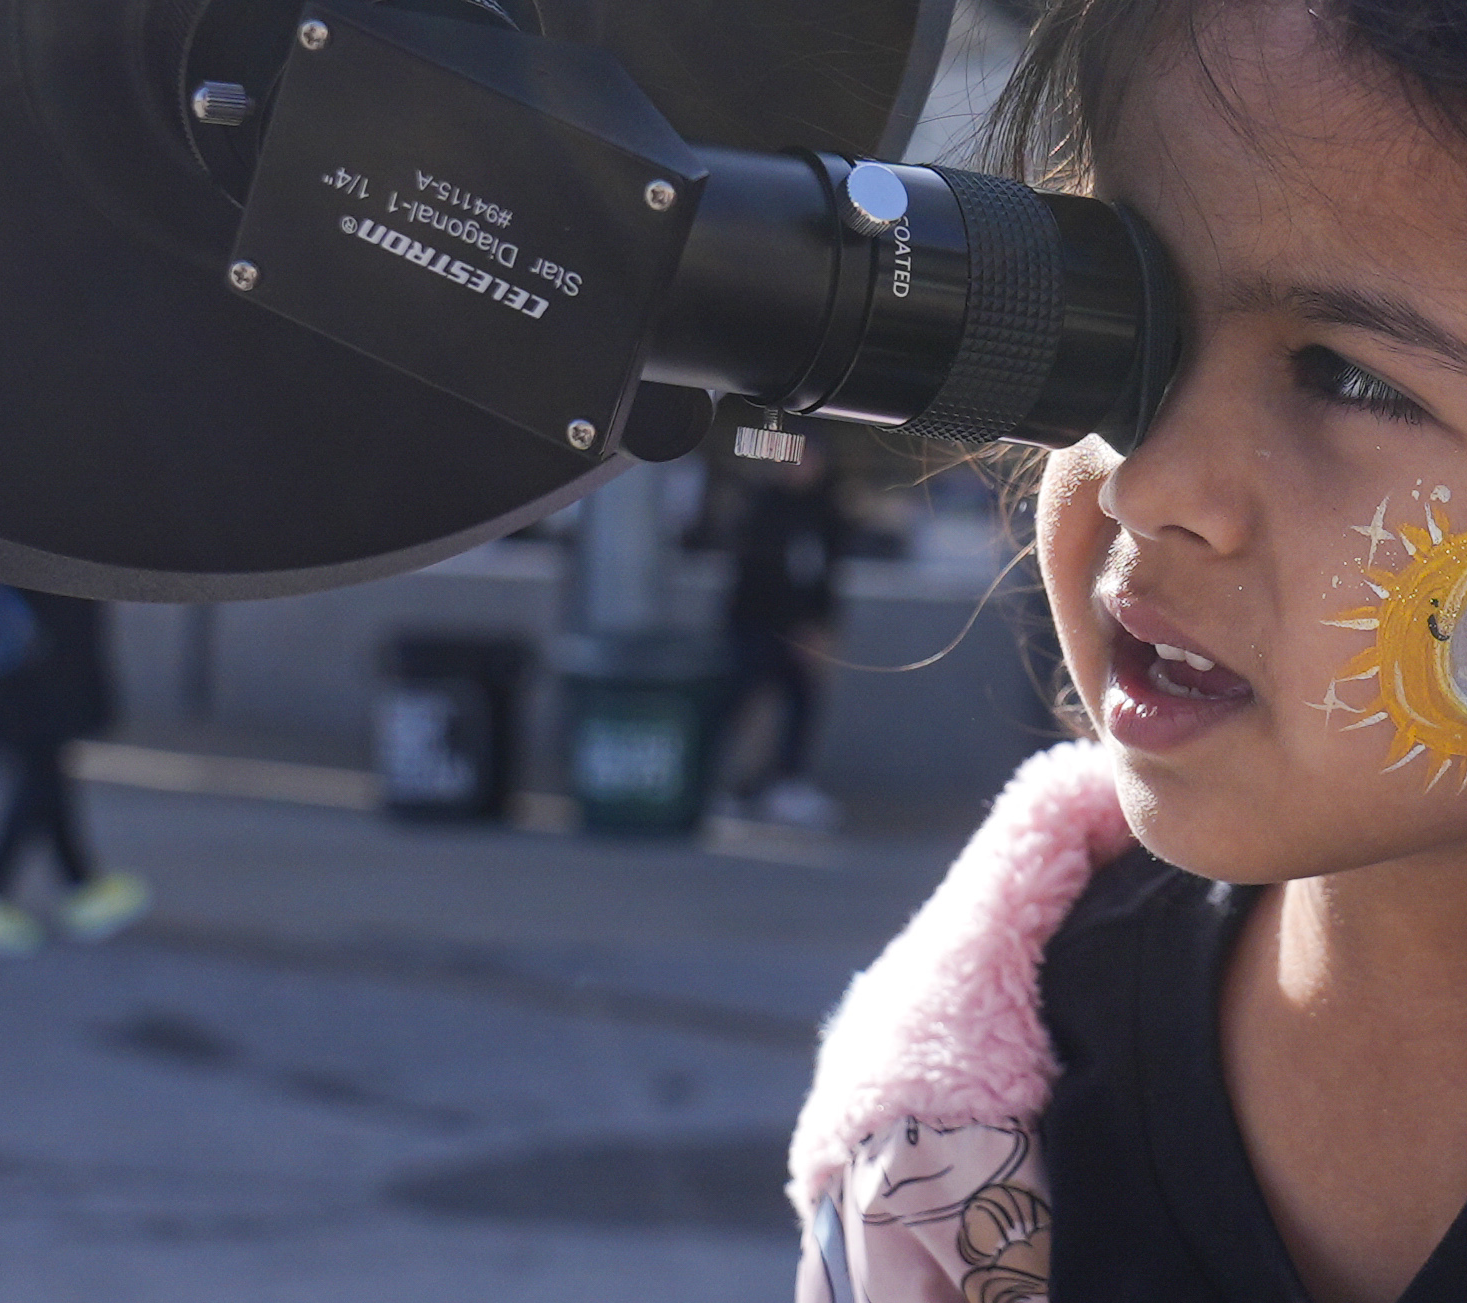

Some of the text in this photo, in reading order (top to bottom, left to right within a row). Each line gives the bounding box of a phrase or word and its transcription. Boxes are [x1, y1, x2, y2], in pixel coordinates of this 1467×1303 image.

[321, 166, 584, 297] Star Diagonal-1 1/4"
[415, 168, 514, 229] #94115-A
